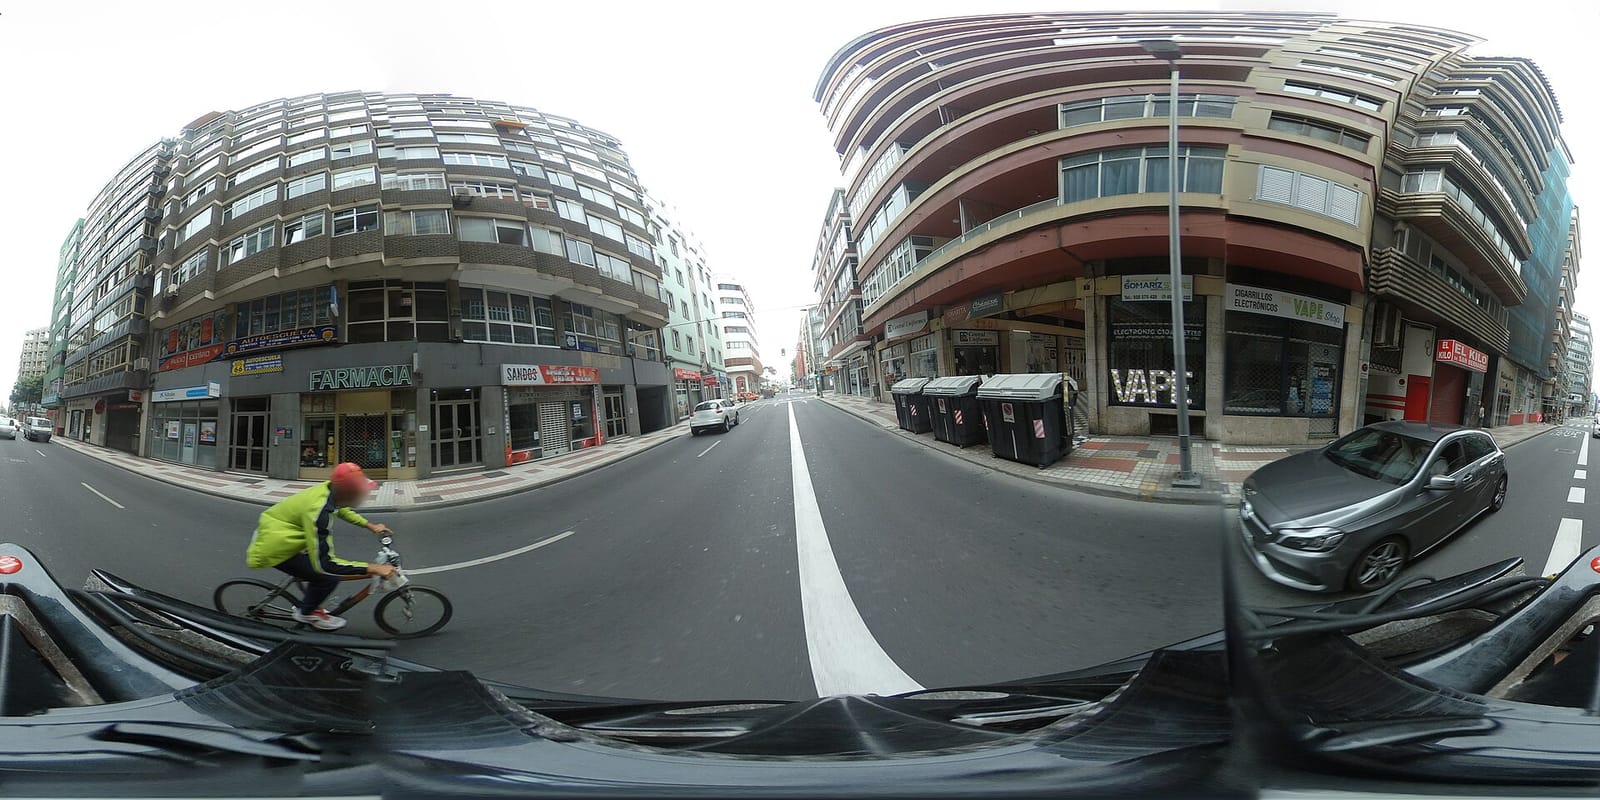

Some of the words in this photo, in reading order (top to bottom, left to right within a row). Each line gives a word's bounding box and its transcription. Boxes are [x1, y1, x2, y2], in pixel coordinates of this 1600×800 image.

[1234, 289, 1273, 302] CIGARRILLOS
[1234, 299, 1279, 313] ELECTRÓNICOS
[1293, 298, 1323, 321] VAPE
[1324, 311, 1340, 325] Shop
[241, 328, 316, 344] AUTOESCUELA
[1442, 341, 1449, 349] EL
[245, 355, 281, 363] AUTOESCUELA
[1438, 352, 1451, 360] KILO
[1454, 343, 1466, 357] EL
[1469, 350, 1487, 365] KILO
[310, 365, 411, 390] FARMACIA
[506, 367, 538, 381] SANDOS
[1110, 368, 1193, 404] VAPE
